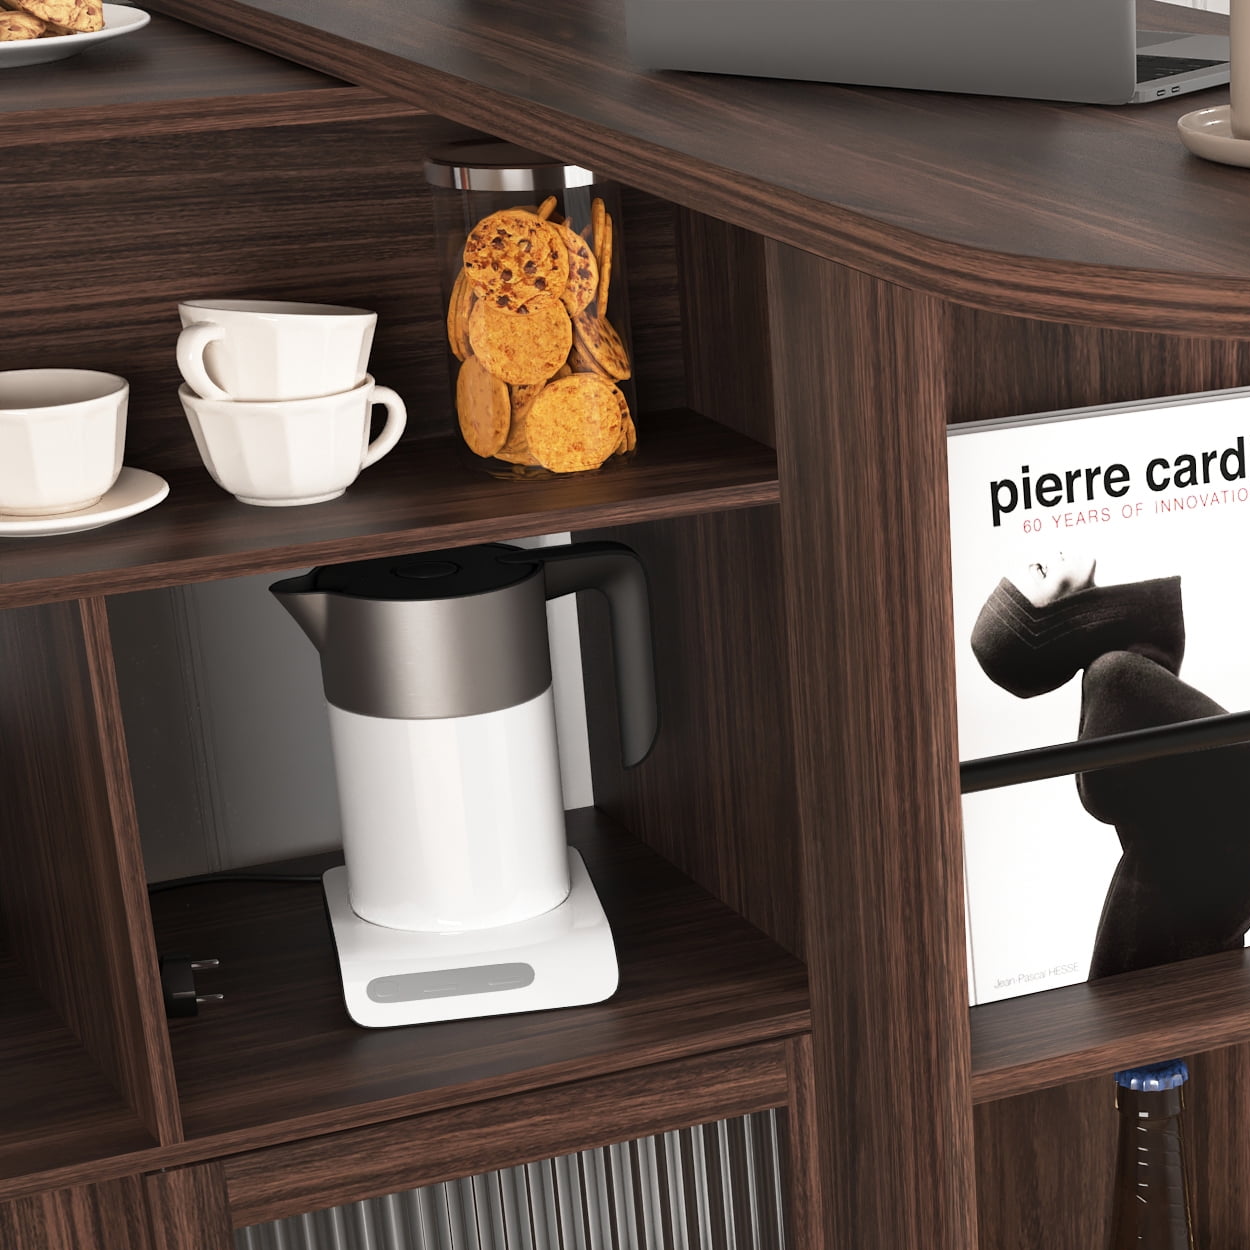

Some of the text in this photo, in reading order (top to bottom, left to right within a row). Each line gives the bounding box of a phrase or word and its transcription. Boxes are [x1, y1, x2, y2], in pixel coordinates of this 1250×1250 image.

[990, 464, 1131, 528] pierre
[1023, 517, 1043, 534] 60
[1052, 507, 1112, 529] YEARS
[1121, 502, 1144, 520] OF
[1048, 961, 1080, 978] HESSE
